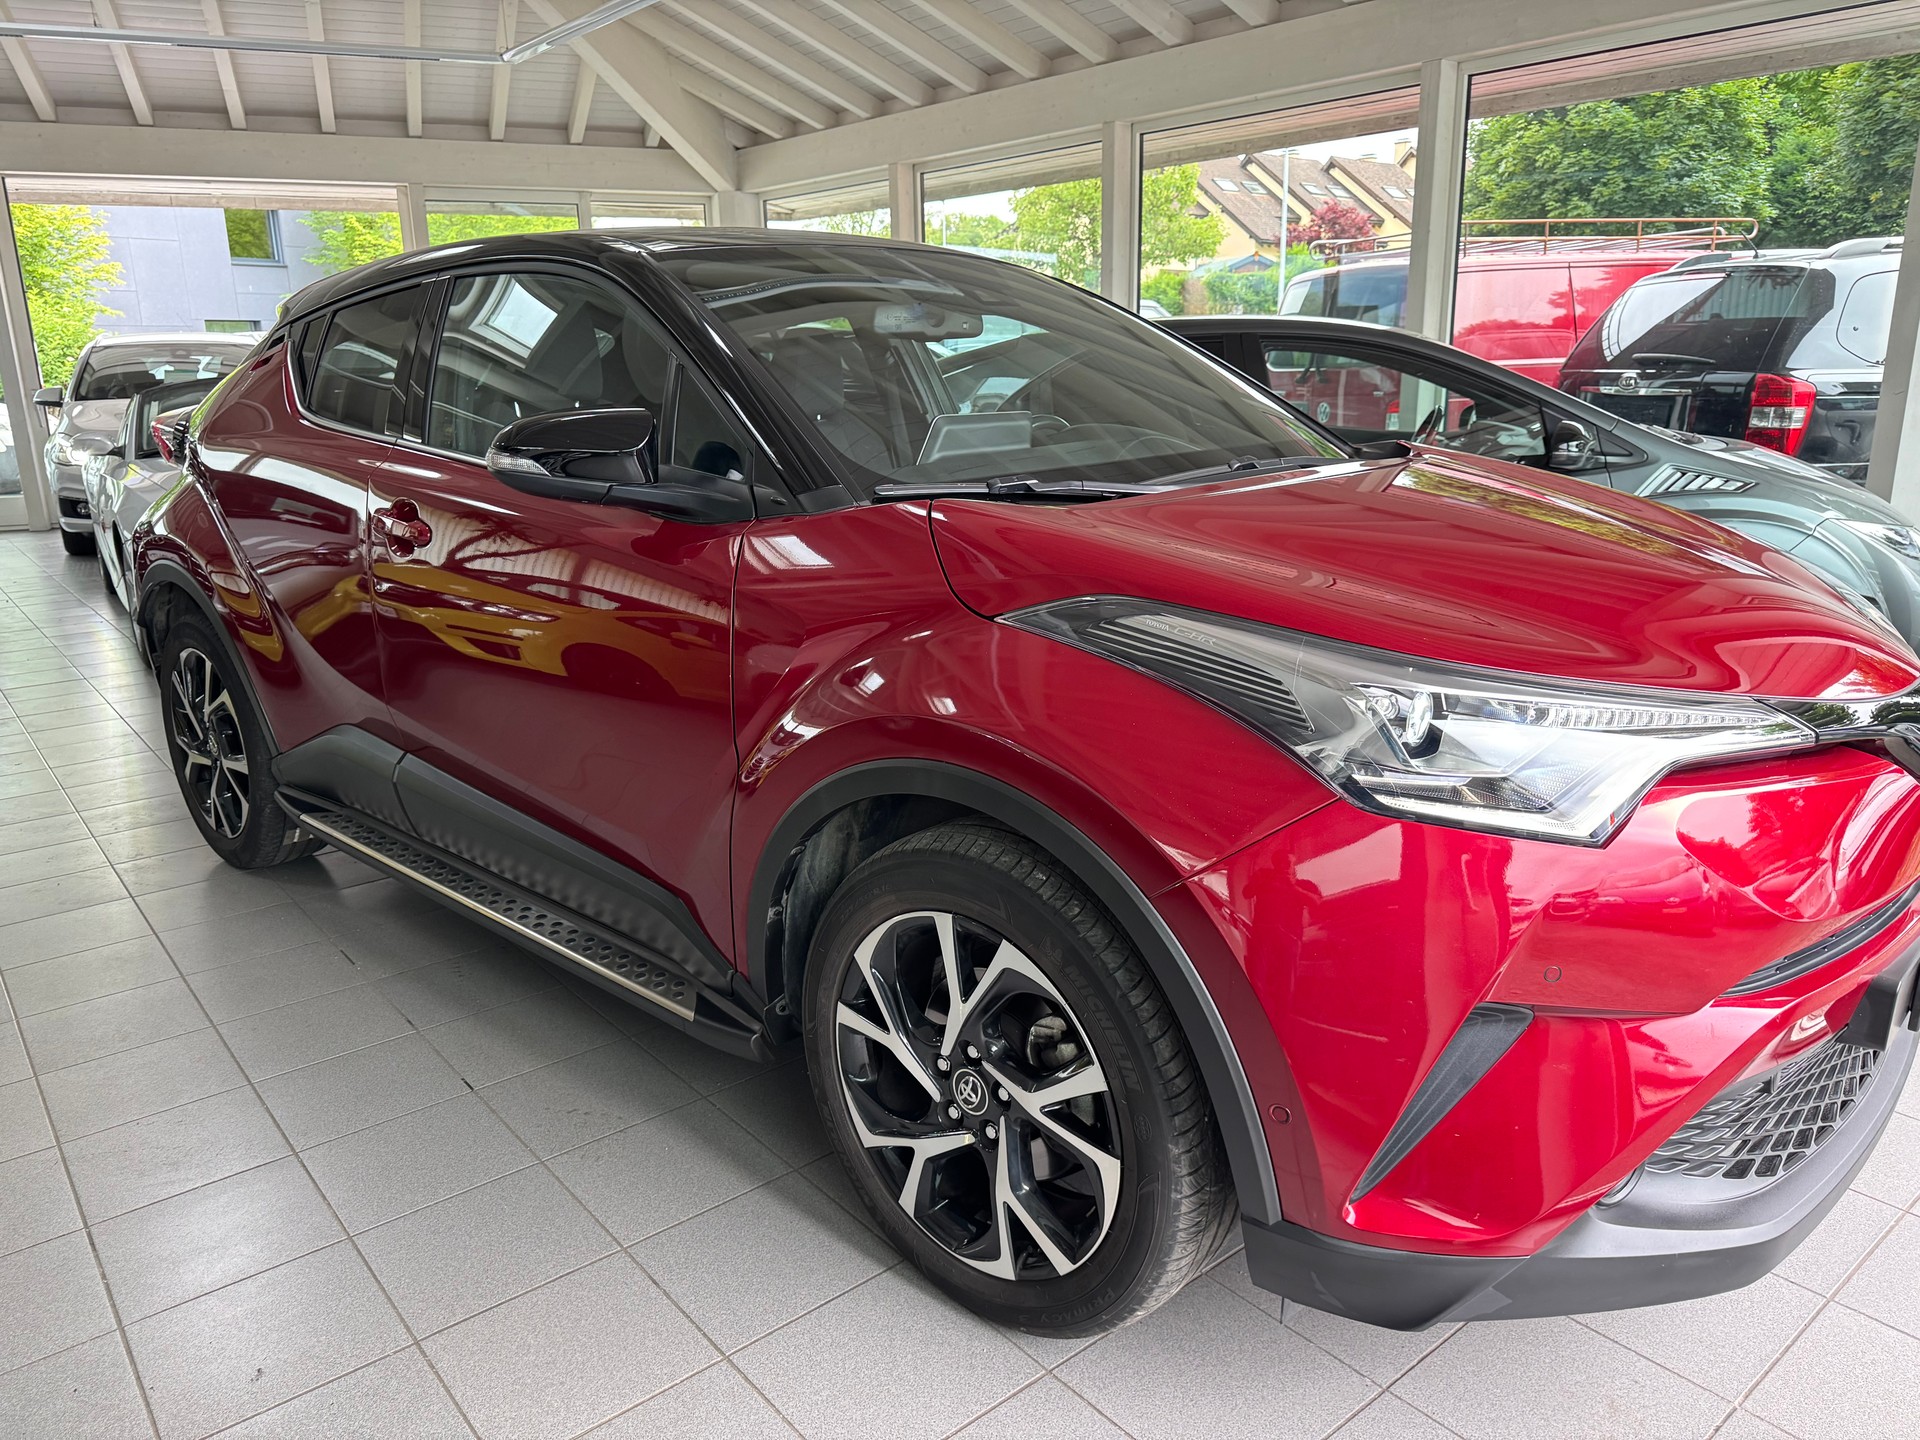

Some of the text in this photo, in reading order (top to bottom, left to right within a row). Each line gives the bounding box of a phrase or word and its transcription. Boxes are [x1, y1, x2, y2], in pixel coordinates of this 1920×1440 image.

[1146, 619, 1216, 646] TOYOTA C-HR
[1063, 958, 1142, 1092] MICHELIN
[1040, 1287, 1116, 1324] PRIMACY
